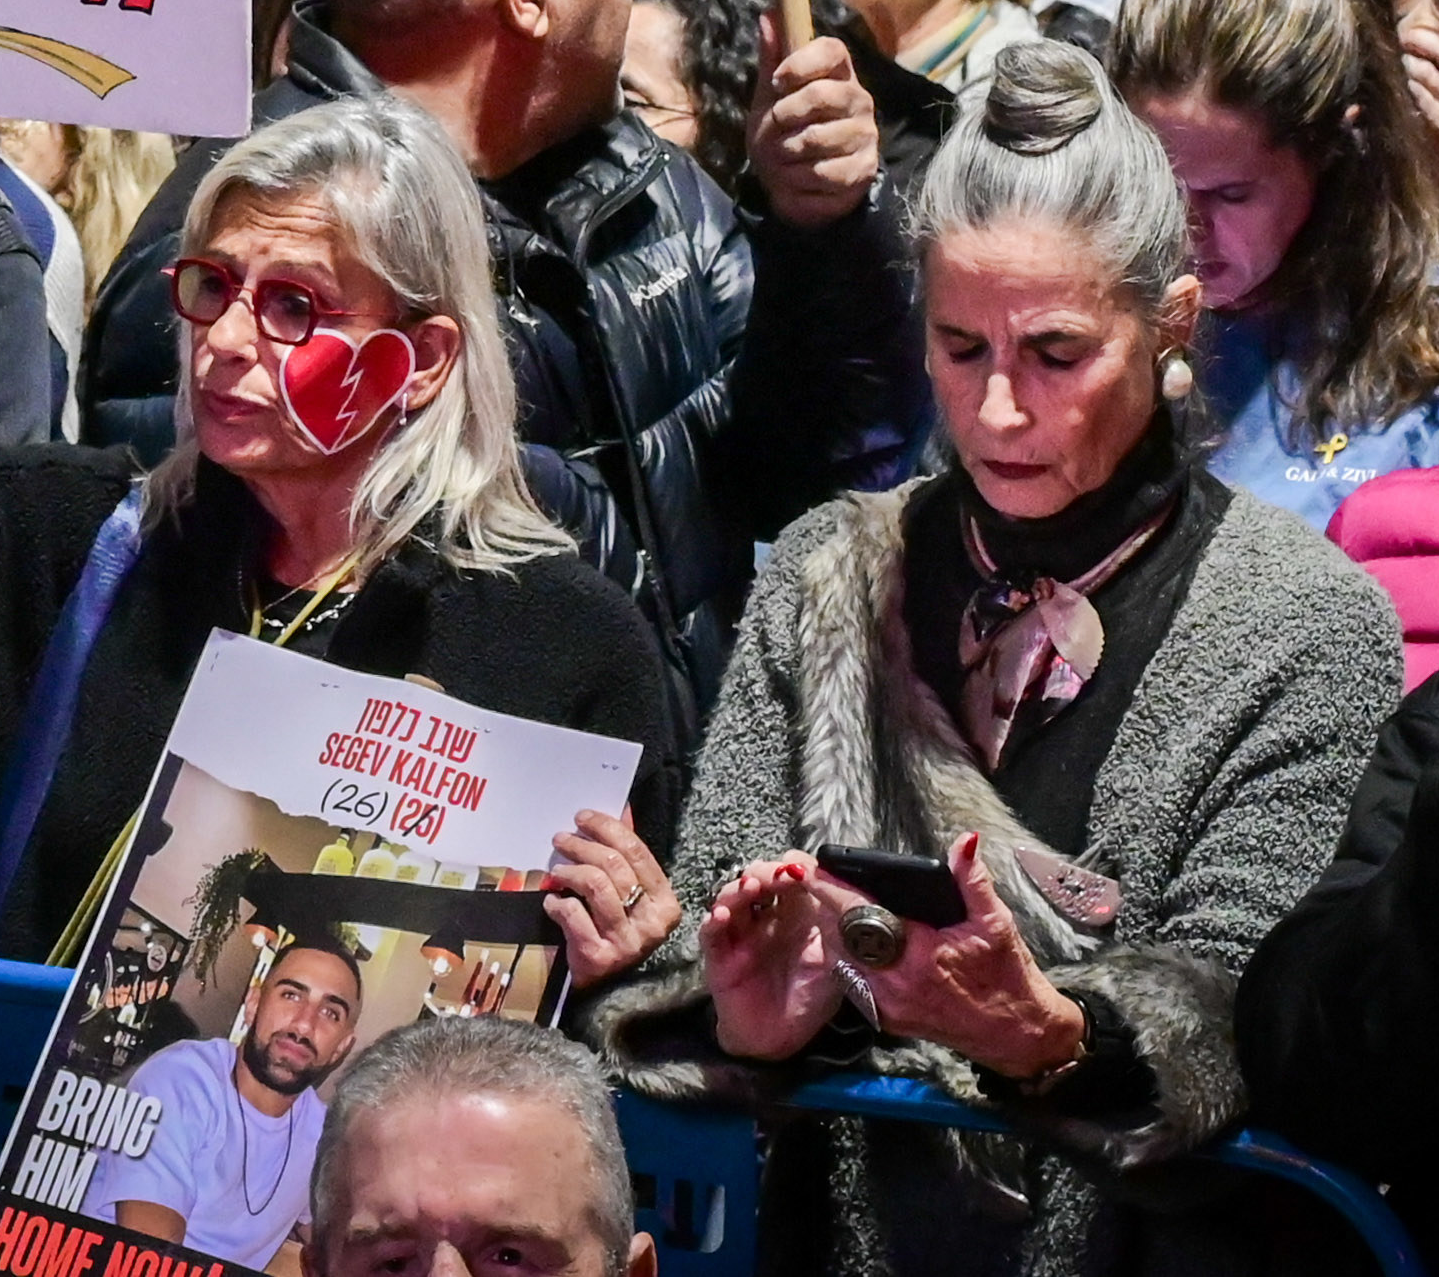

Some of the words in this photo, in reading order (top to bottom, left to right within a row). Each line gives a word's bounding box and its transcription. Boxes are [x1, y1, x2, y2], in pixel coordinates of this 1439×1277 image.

[355, 698, 415, 743] כלפון
[420, 715, 476, 764] שגב
[319, 732, 385, 777] SEGEV
[388, 749, 487, 811] KALFON
[38, 1069, 162, 1159] BRING
[14, 1134, 100, 1213] HIM
